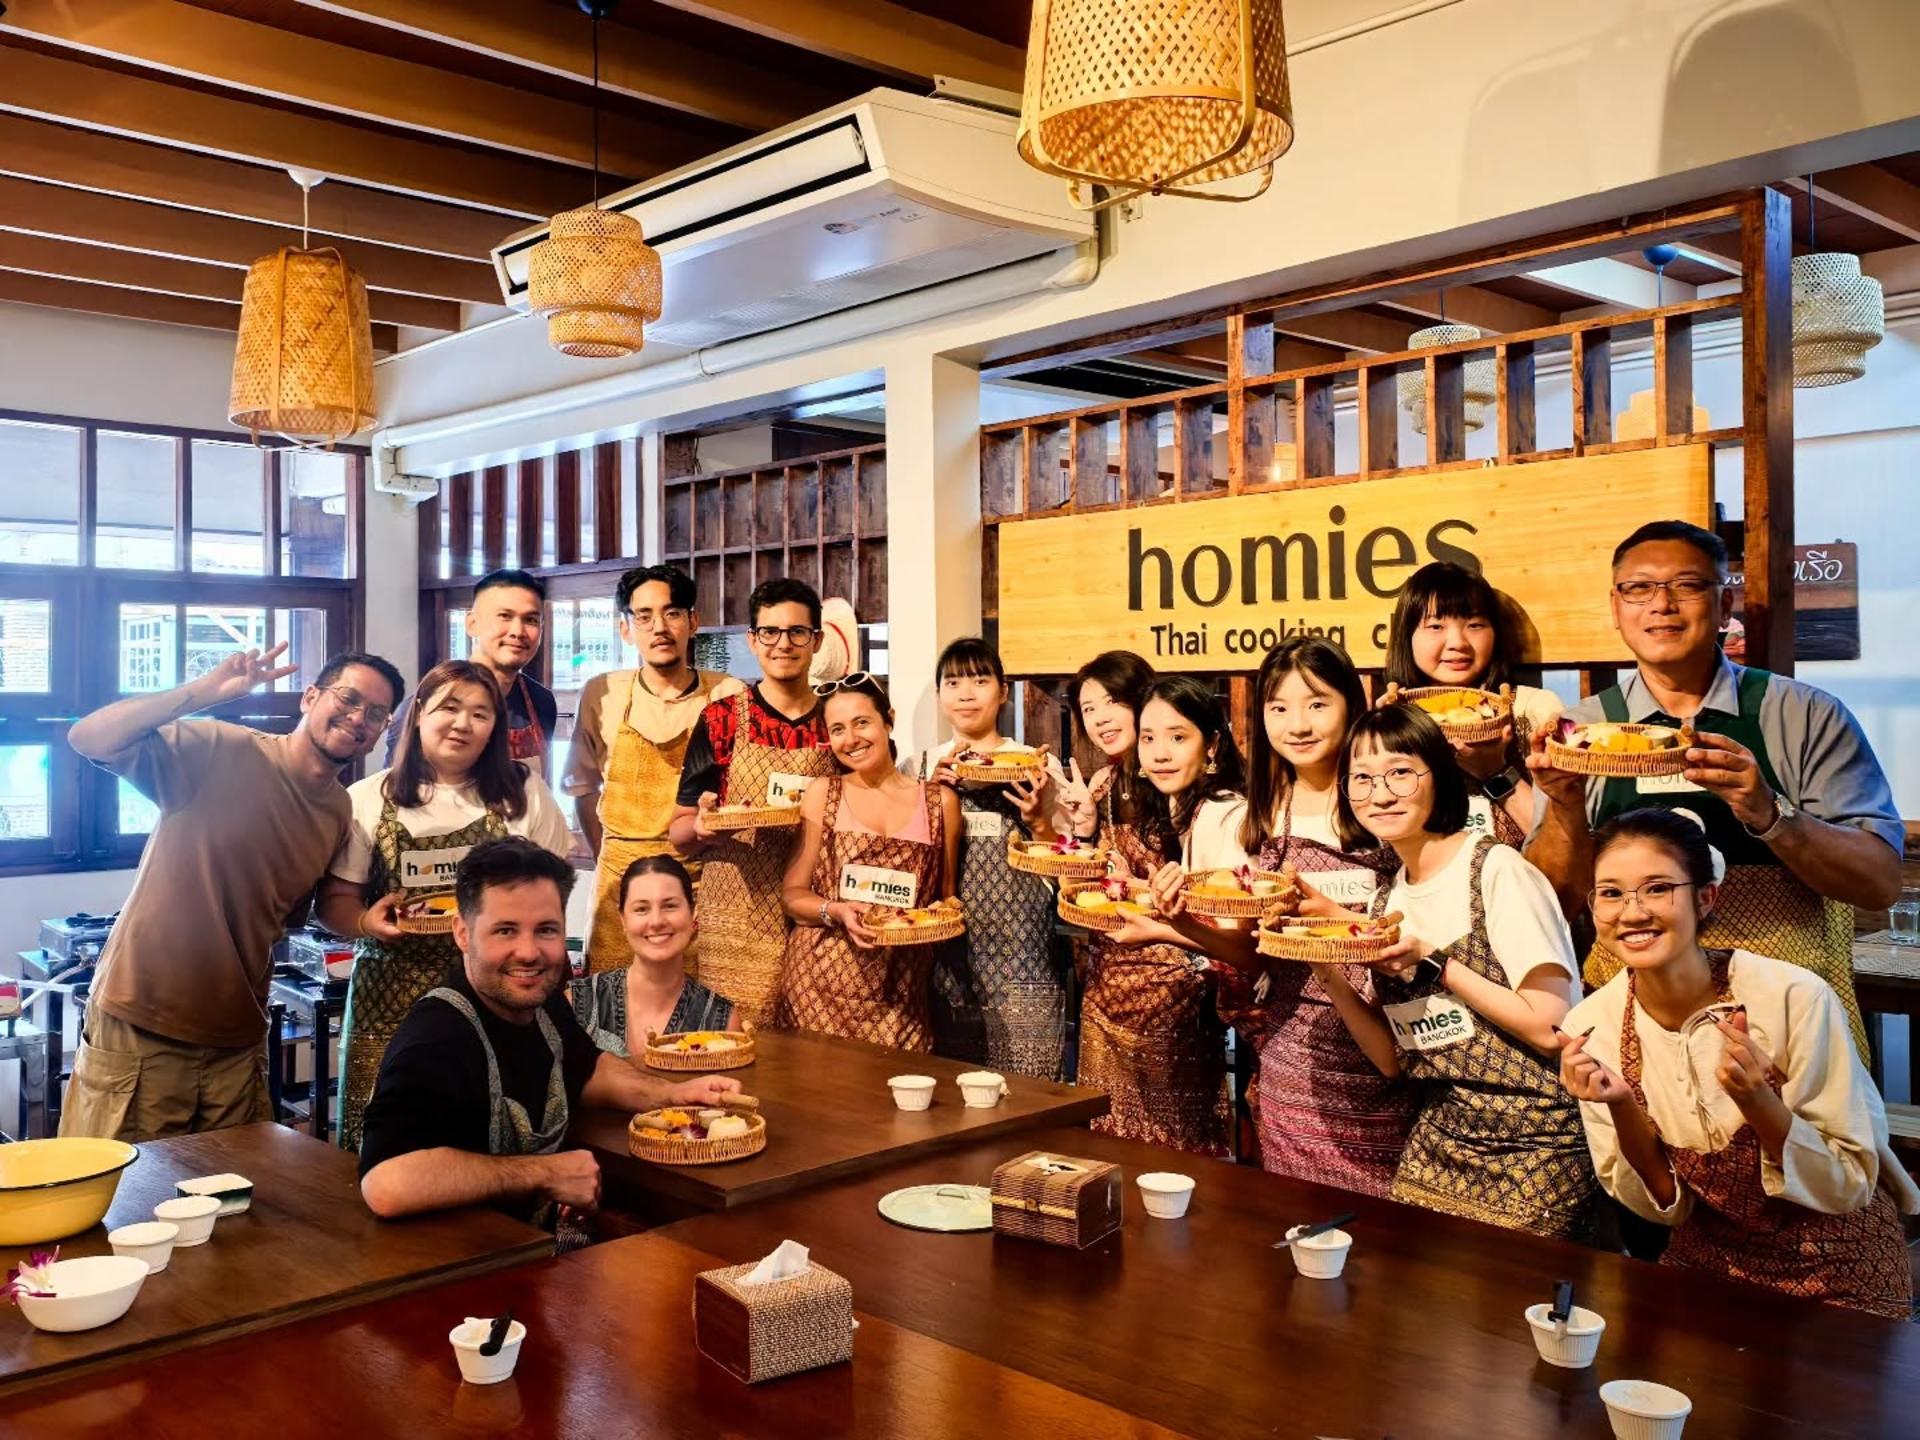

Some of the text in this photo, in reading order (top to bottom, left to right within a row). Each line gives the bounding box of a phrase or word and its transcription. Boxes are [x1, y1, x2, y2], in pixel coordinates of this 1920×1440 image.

[1128, 505, 1482, 610] homies
[1151, 621, 1208, 655] Thai
[1421, 1025, 1467, 1044] BANGKOK
